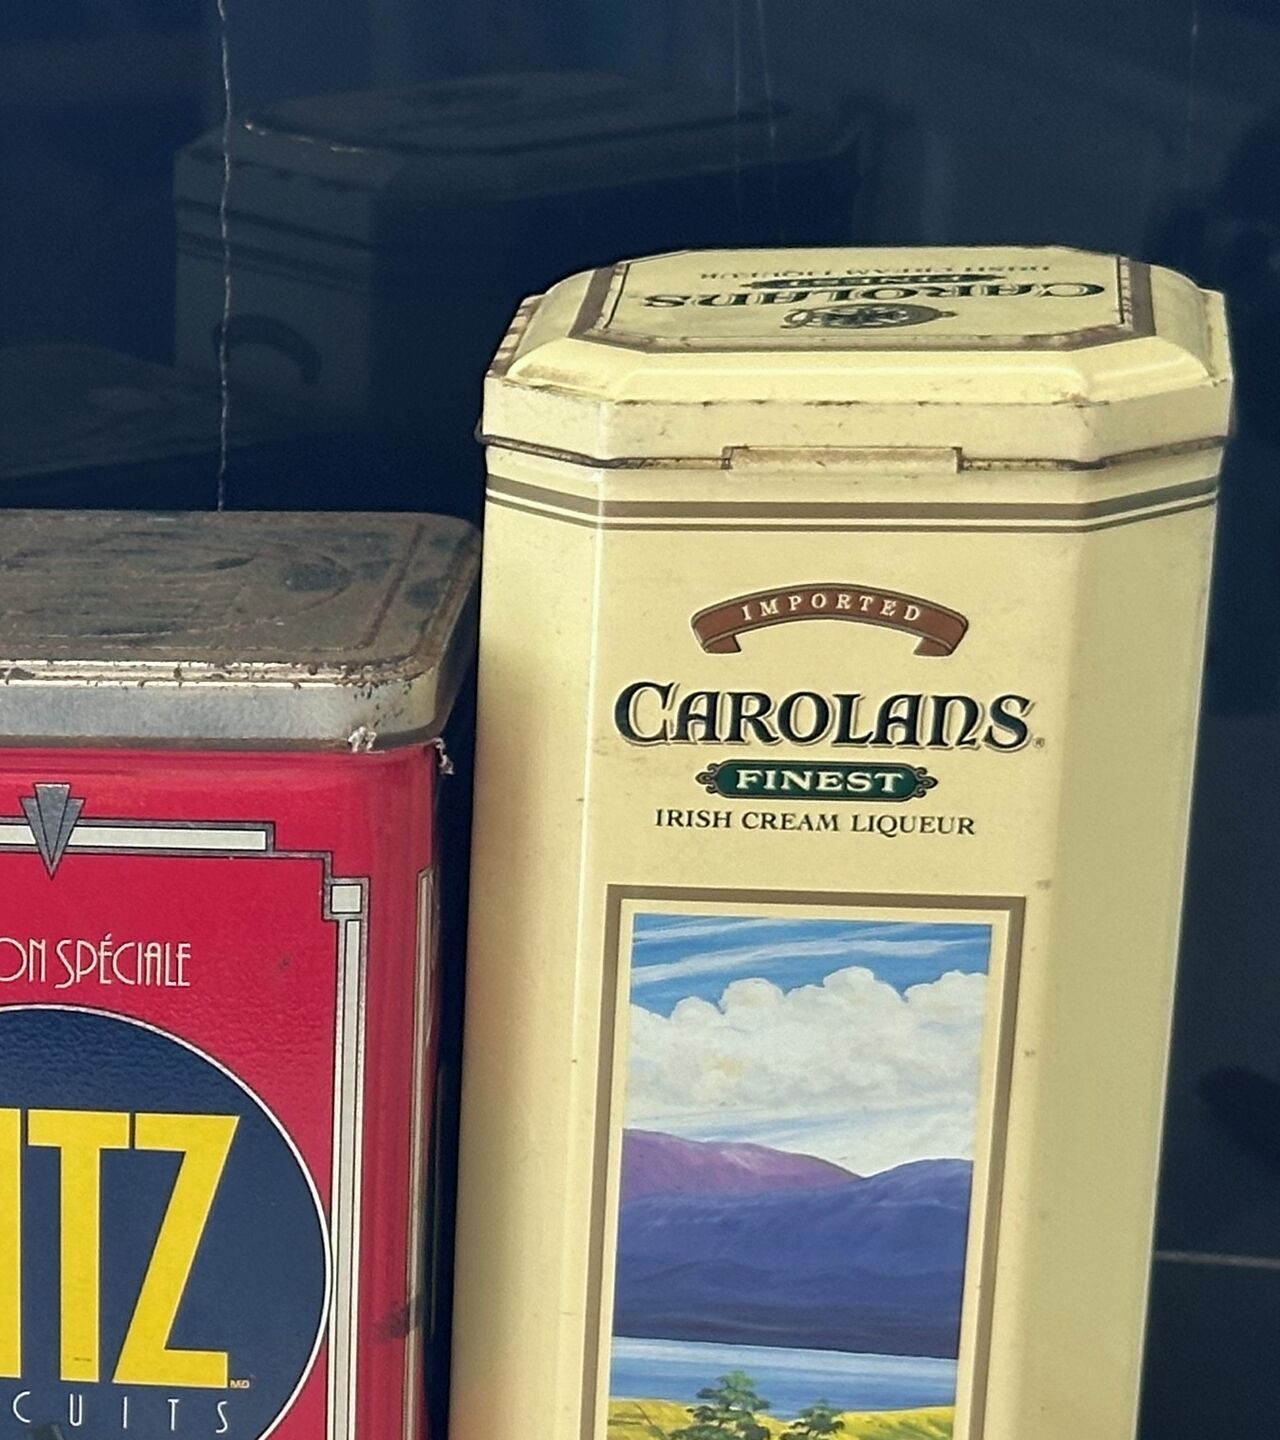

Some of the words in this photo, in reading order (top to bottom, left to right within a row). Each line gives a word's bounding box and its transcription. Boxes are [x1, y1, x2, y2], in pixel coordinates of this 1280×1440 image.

[741, 593, 922, 623] IMPORTED
[614, 681, 1036, 750] CAROLANS
[736, 769, 903, 794] FINEST
[655, 809, 732, 829] IRISH
[741, 811, 840, 832] CREAM
[851, 814, 976, 837] LIQUEUR
[54, 930, 192, 989] SPÉCIALE
